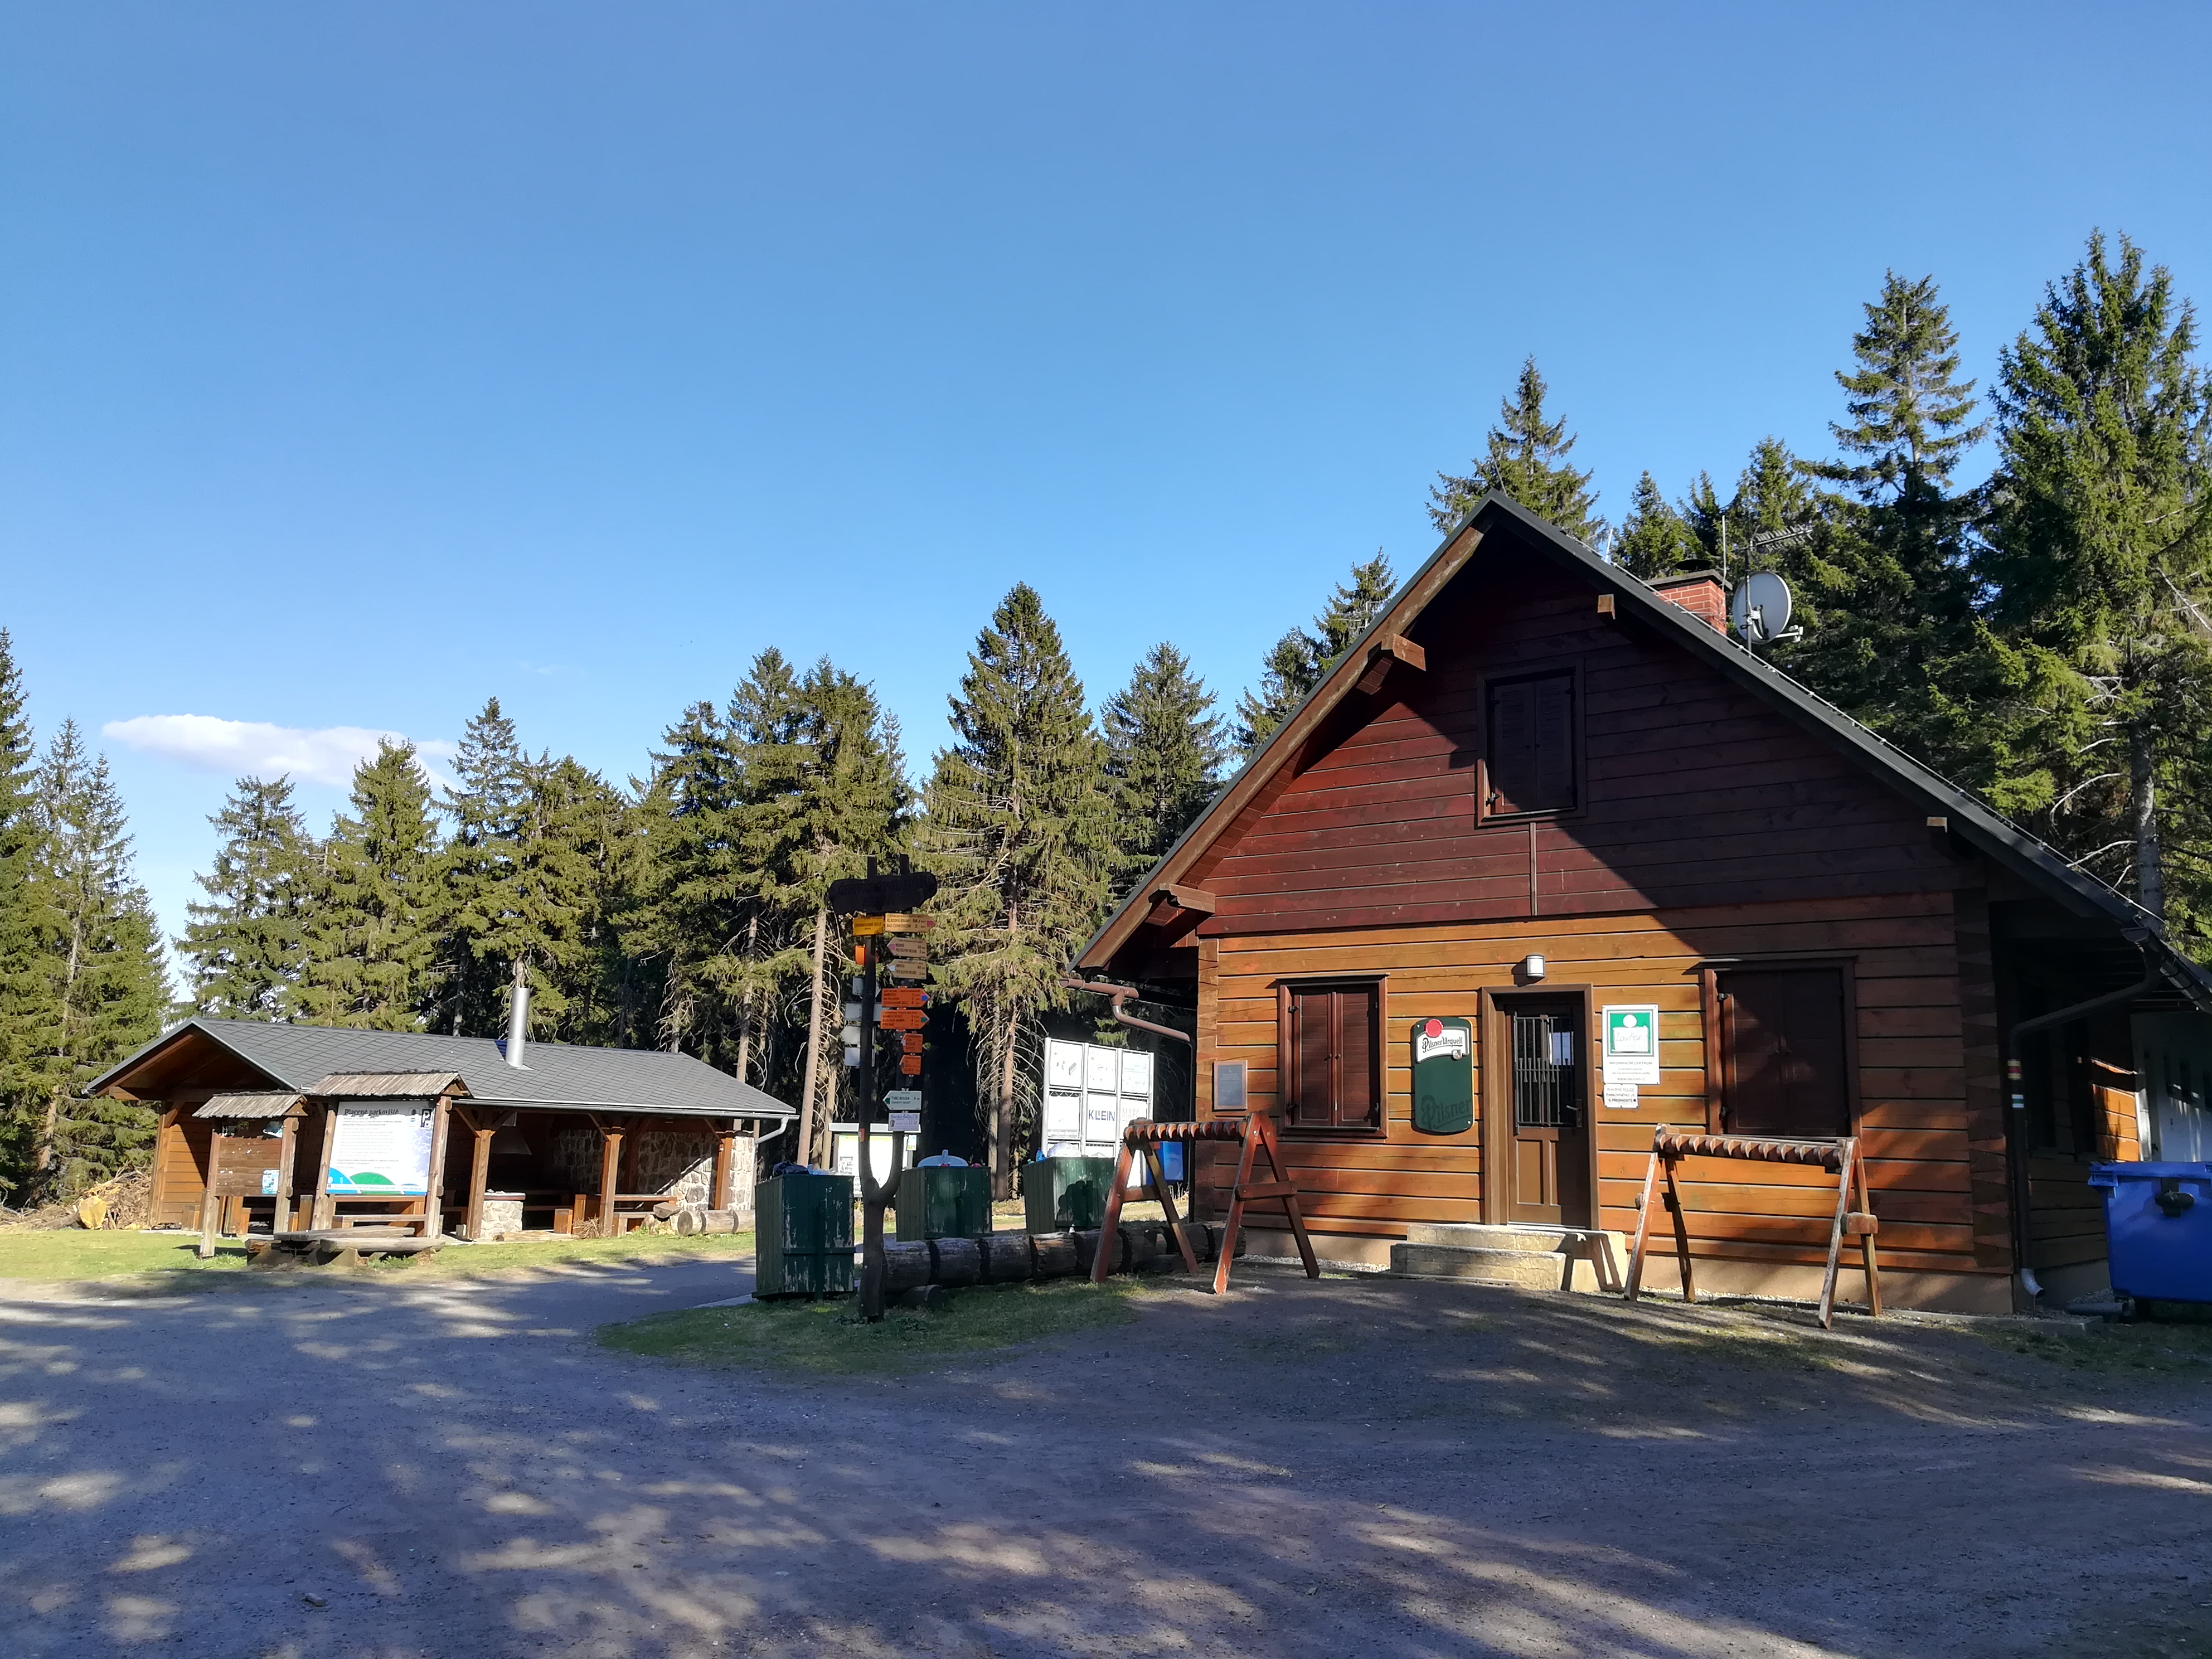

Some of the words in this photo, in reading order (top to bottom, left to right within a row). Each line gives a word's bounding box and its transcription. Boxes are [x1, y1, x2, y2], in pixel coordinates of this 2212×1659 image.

[1422, 1037, 1443, 1054] Pilsner
[1442, 1037, 1463, 1048] Urquell
[368, 1108, 400, 1118] parkoviště
[422, 1110, 430, 1123] P
[1089, 1109, 1115, 1122] KLEIN
[1421, 1094, 1472, 1130] Pilsner
